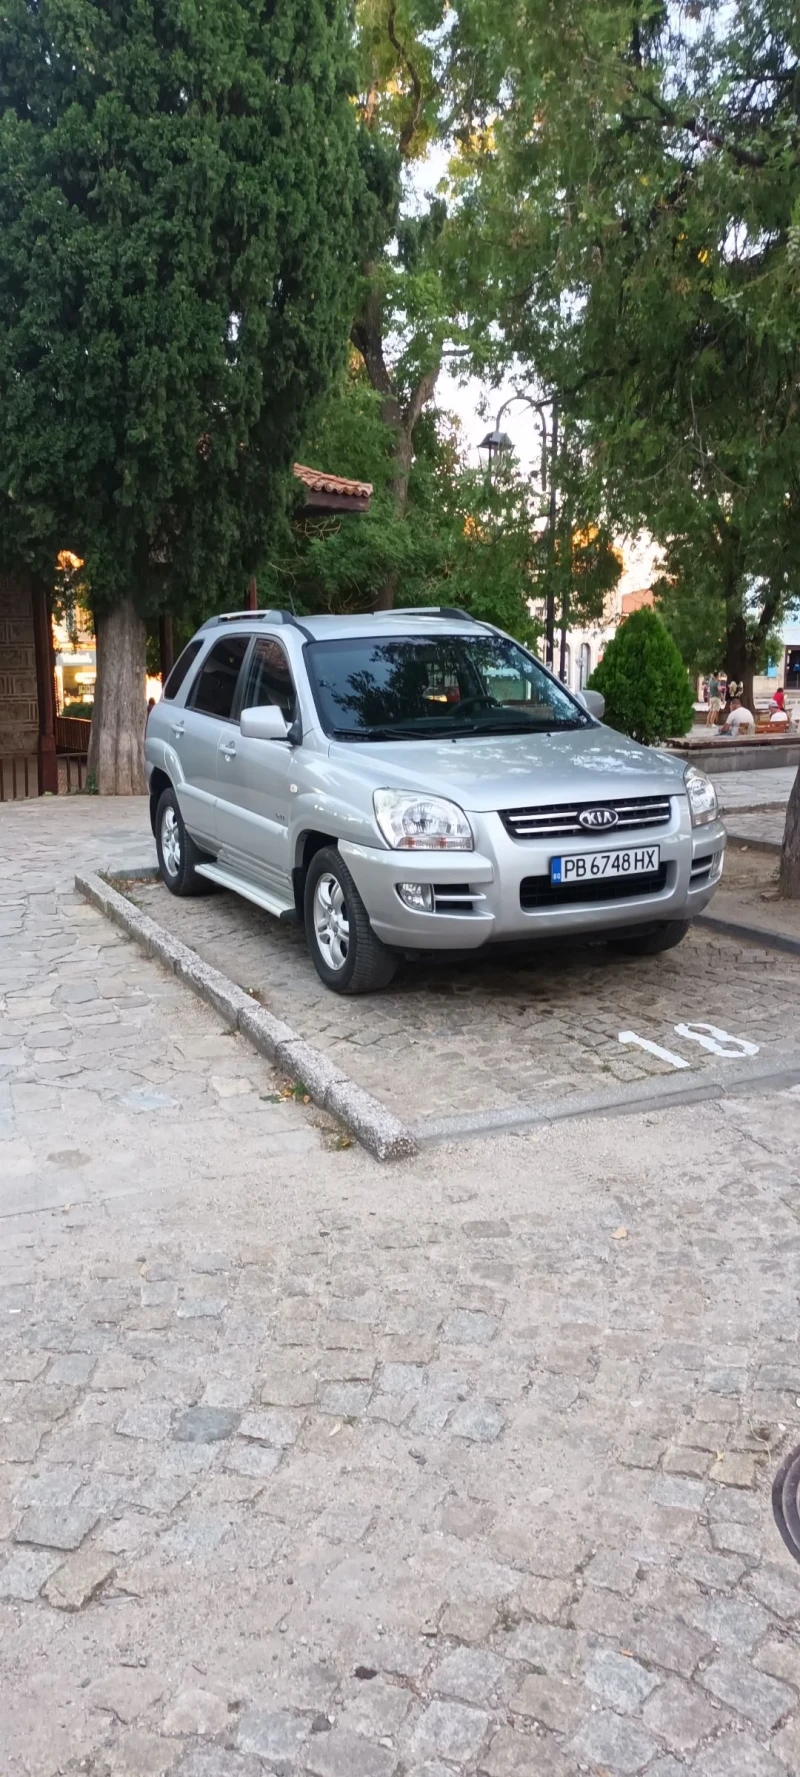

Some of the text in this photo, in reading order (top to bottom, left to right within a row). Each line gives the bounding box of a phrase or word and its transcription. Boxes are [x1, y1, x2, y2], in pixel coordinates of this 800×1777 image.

[586, 811, 613, 825] KIA
[564, 849, 656, 879] PB 6748 HX
[618, 1022, 760, 1068] 18
